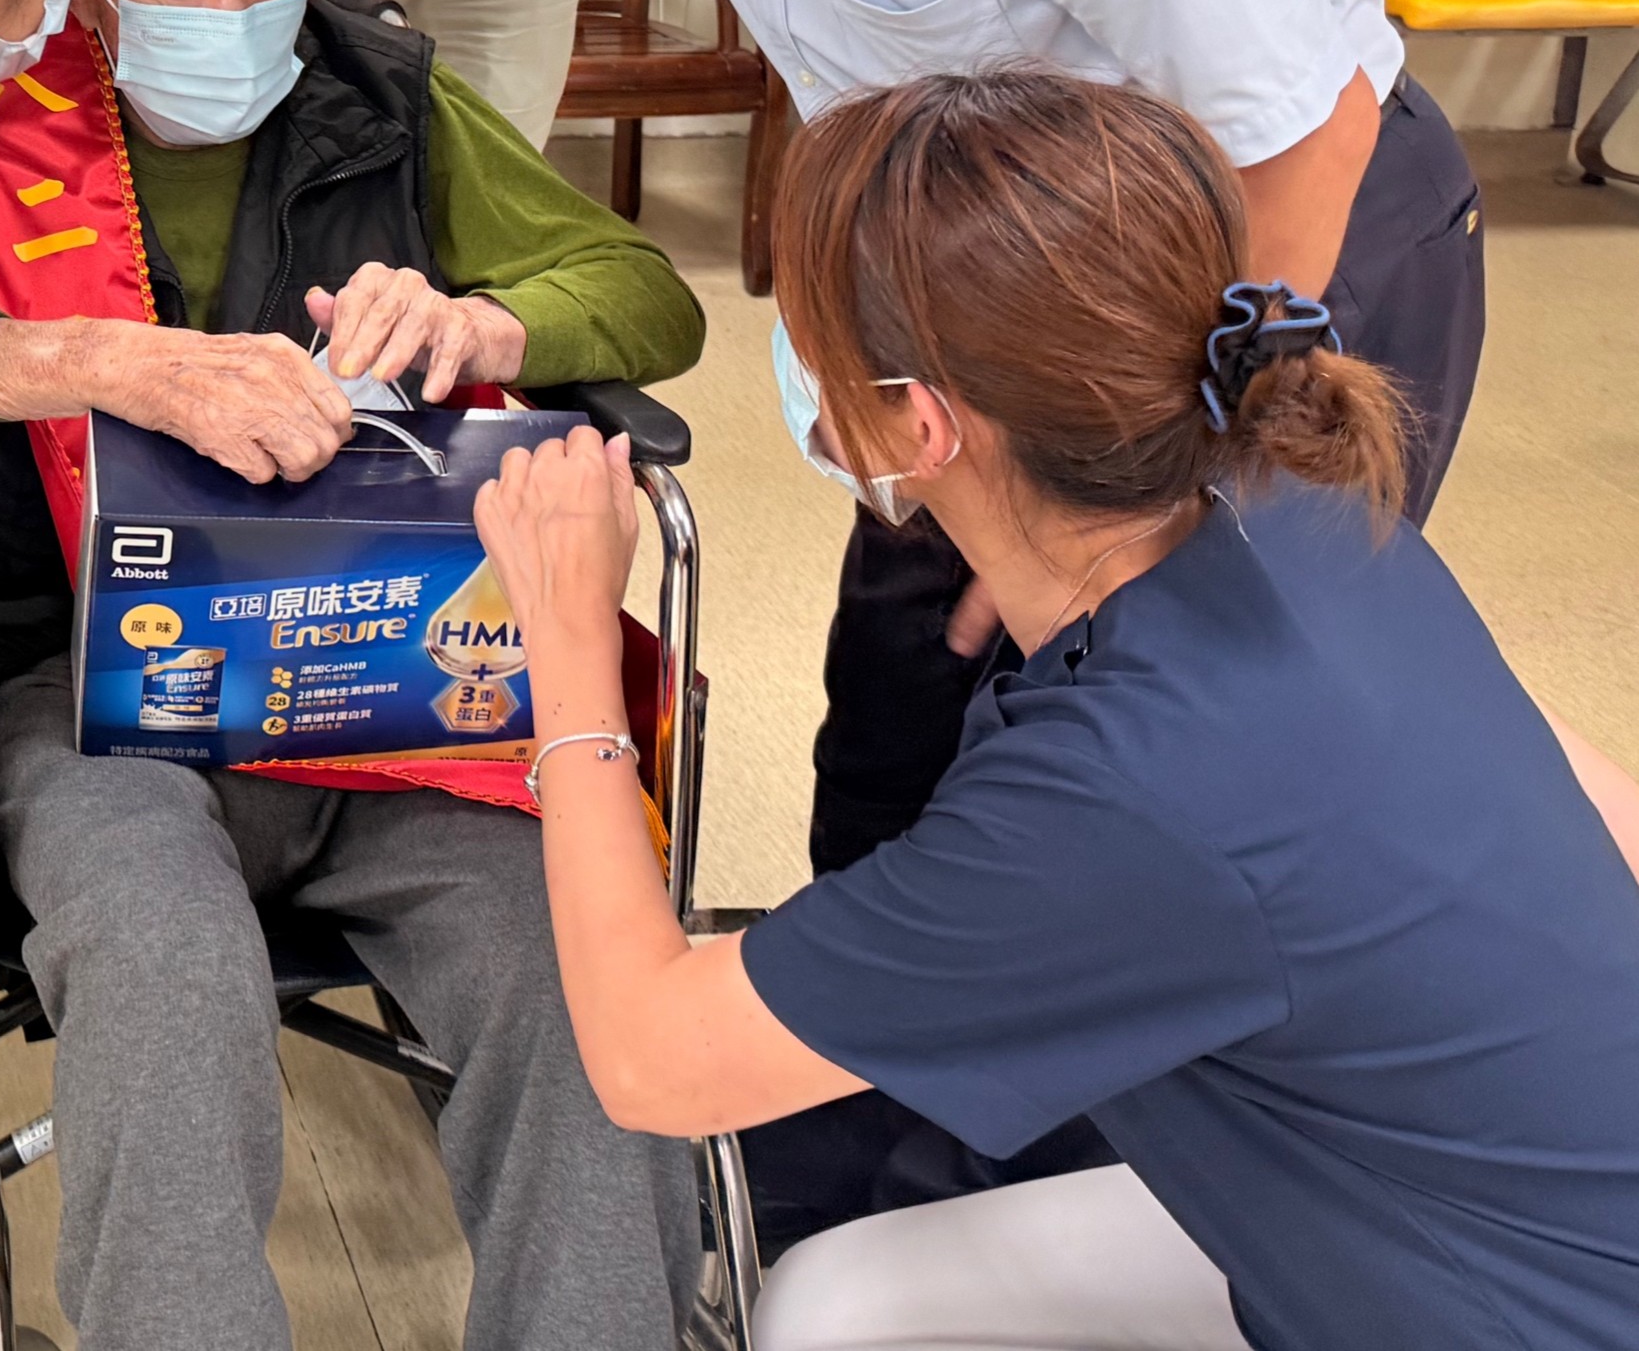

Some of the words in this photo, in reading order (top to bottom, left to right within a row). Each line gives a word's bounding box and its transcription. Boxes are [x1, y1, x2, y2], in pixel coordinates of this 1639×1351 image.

[111, 567, 170, 580] Abbott
[213, 595, 263, 619] 亞培
[266, 575, 423, 621] 原味安素
[130, 620, 172, 634] 原味
[270, 616, 408, 649] Ensure
[300, 660, 367, 675] 添加CaHMB
[268, 696, 288, 707] 28
[458, 686, 496, 704] 3重
[455, 708, 492, 721] 蛋白
